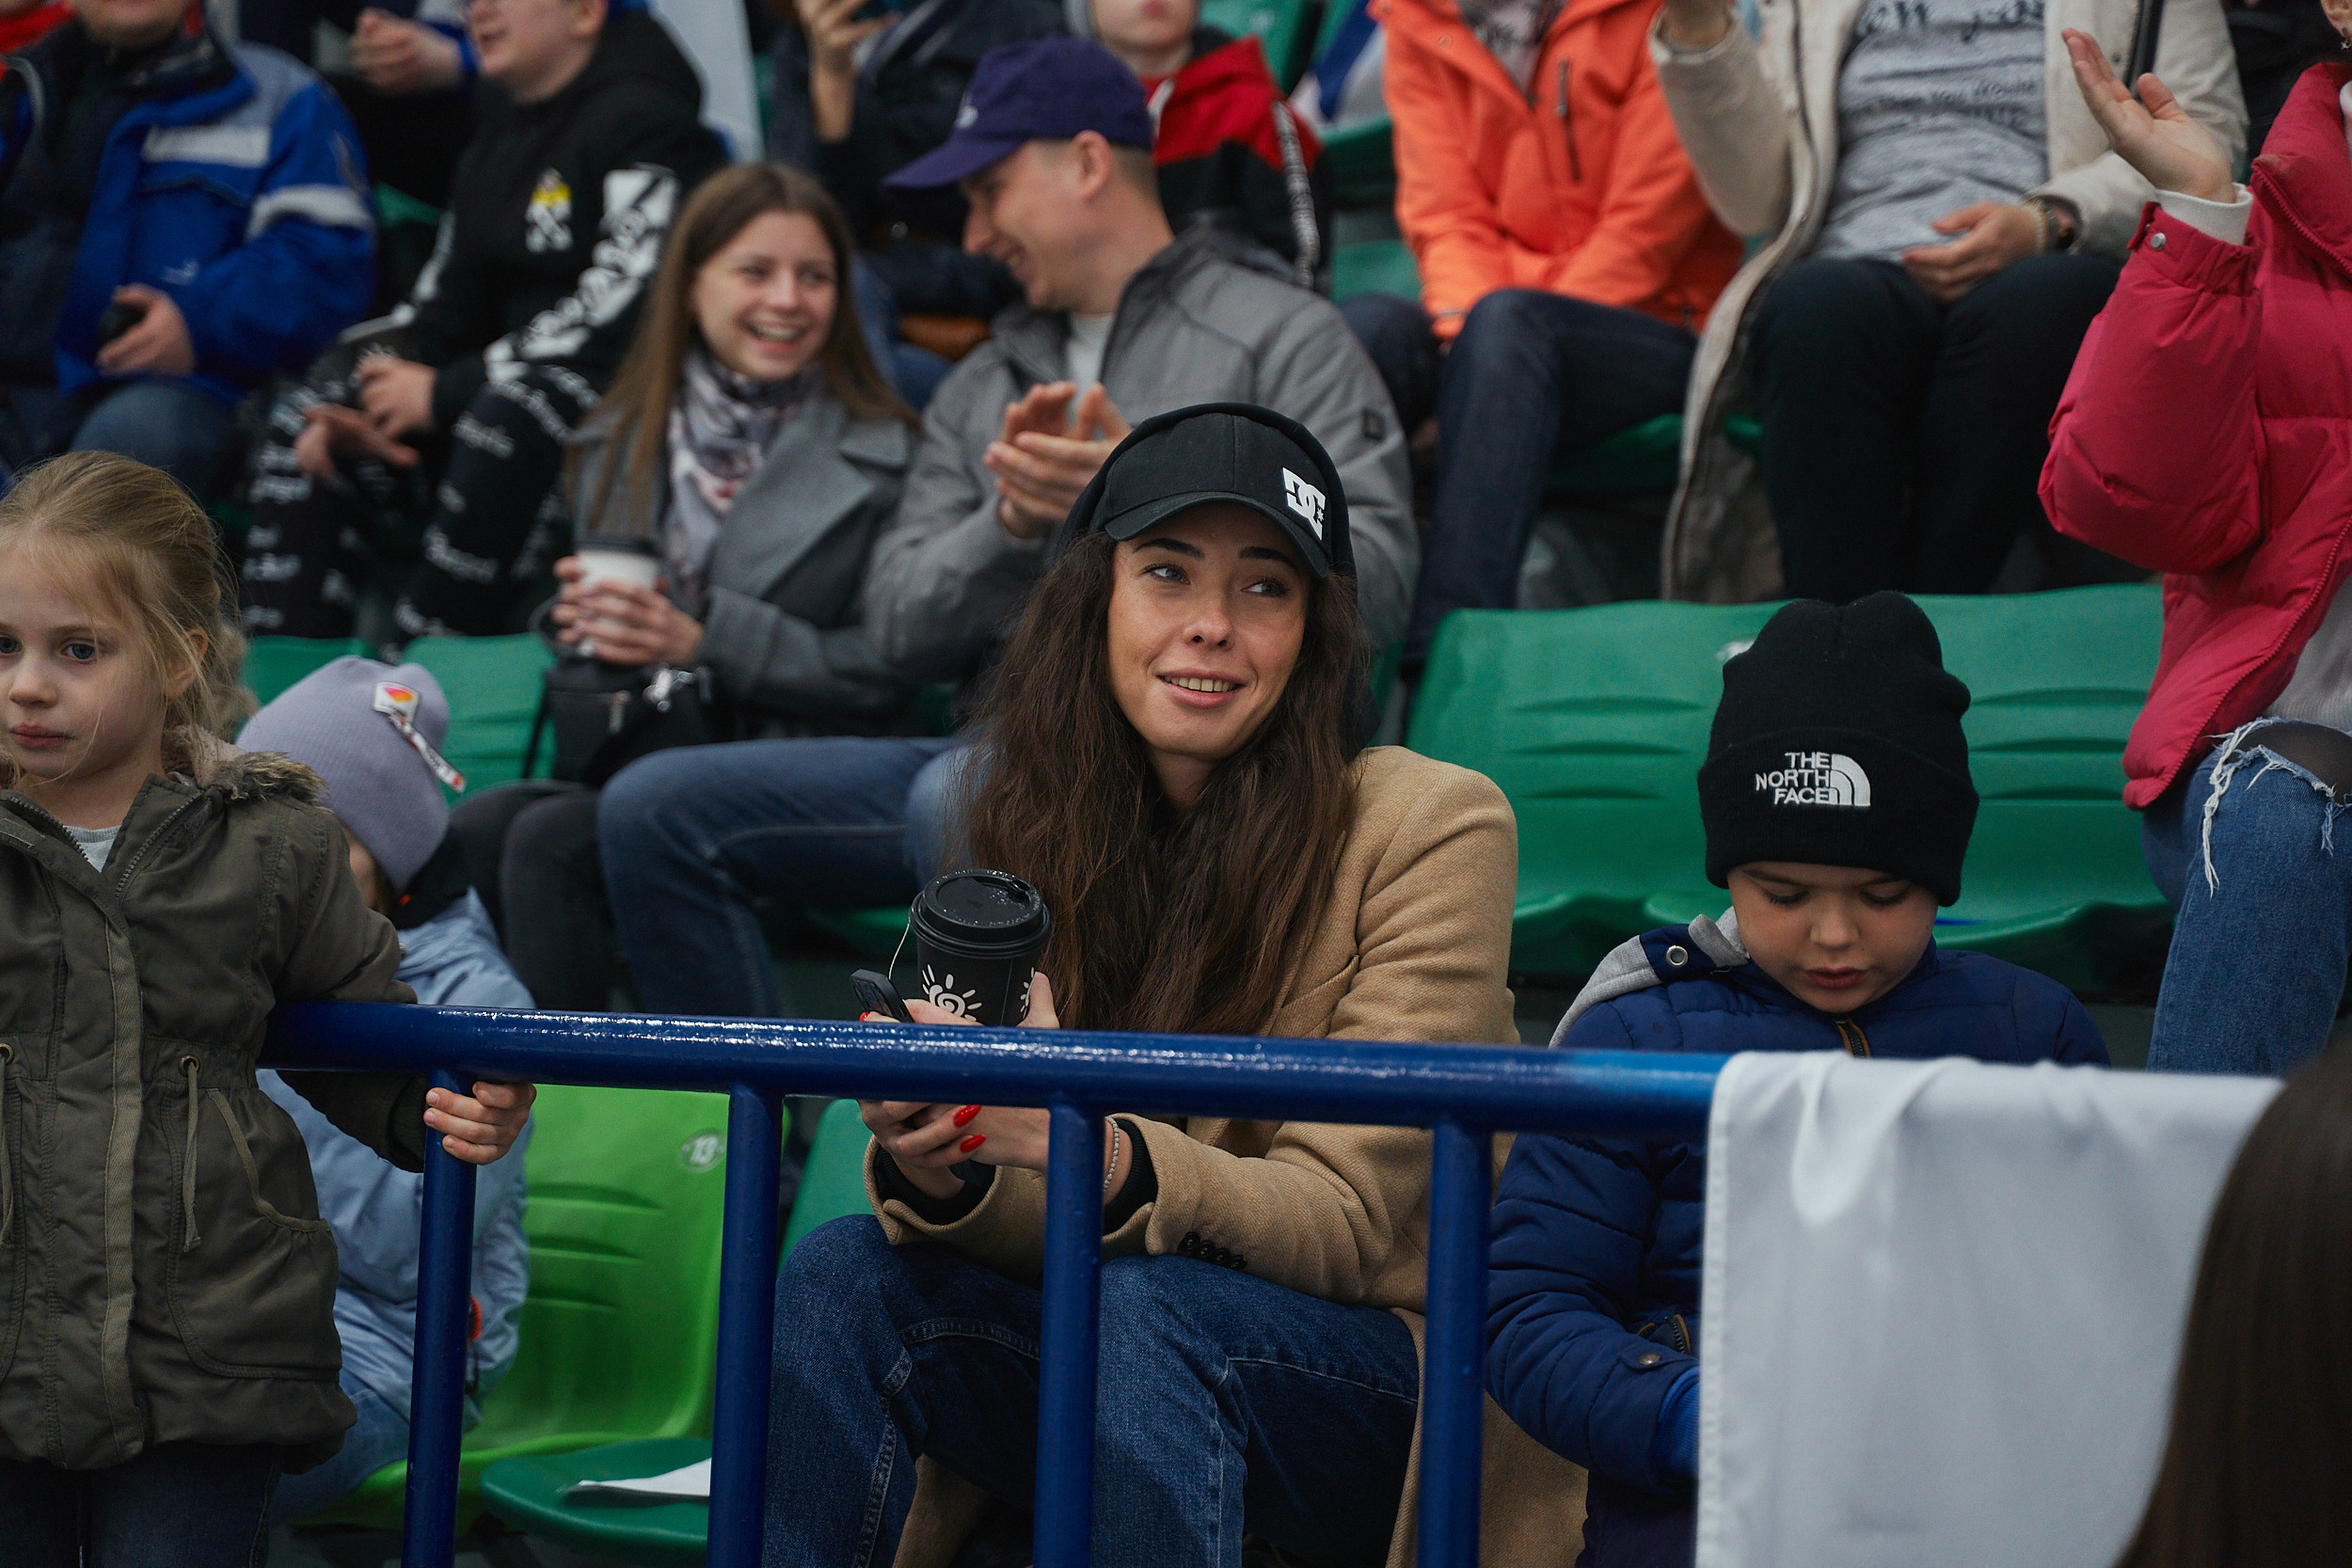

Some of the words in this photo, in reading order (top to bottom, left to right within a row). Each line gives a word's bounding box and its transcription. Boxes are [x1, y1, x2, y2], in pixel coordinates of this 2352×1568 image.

[1282, 467, 1326, 541] DC
[1785, 752, 1830, 768] THE
[1755, 768, 1830, 791] NORTH
[1774, 787, 1830, 805] FACE
